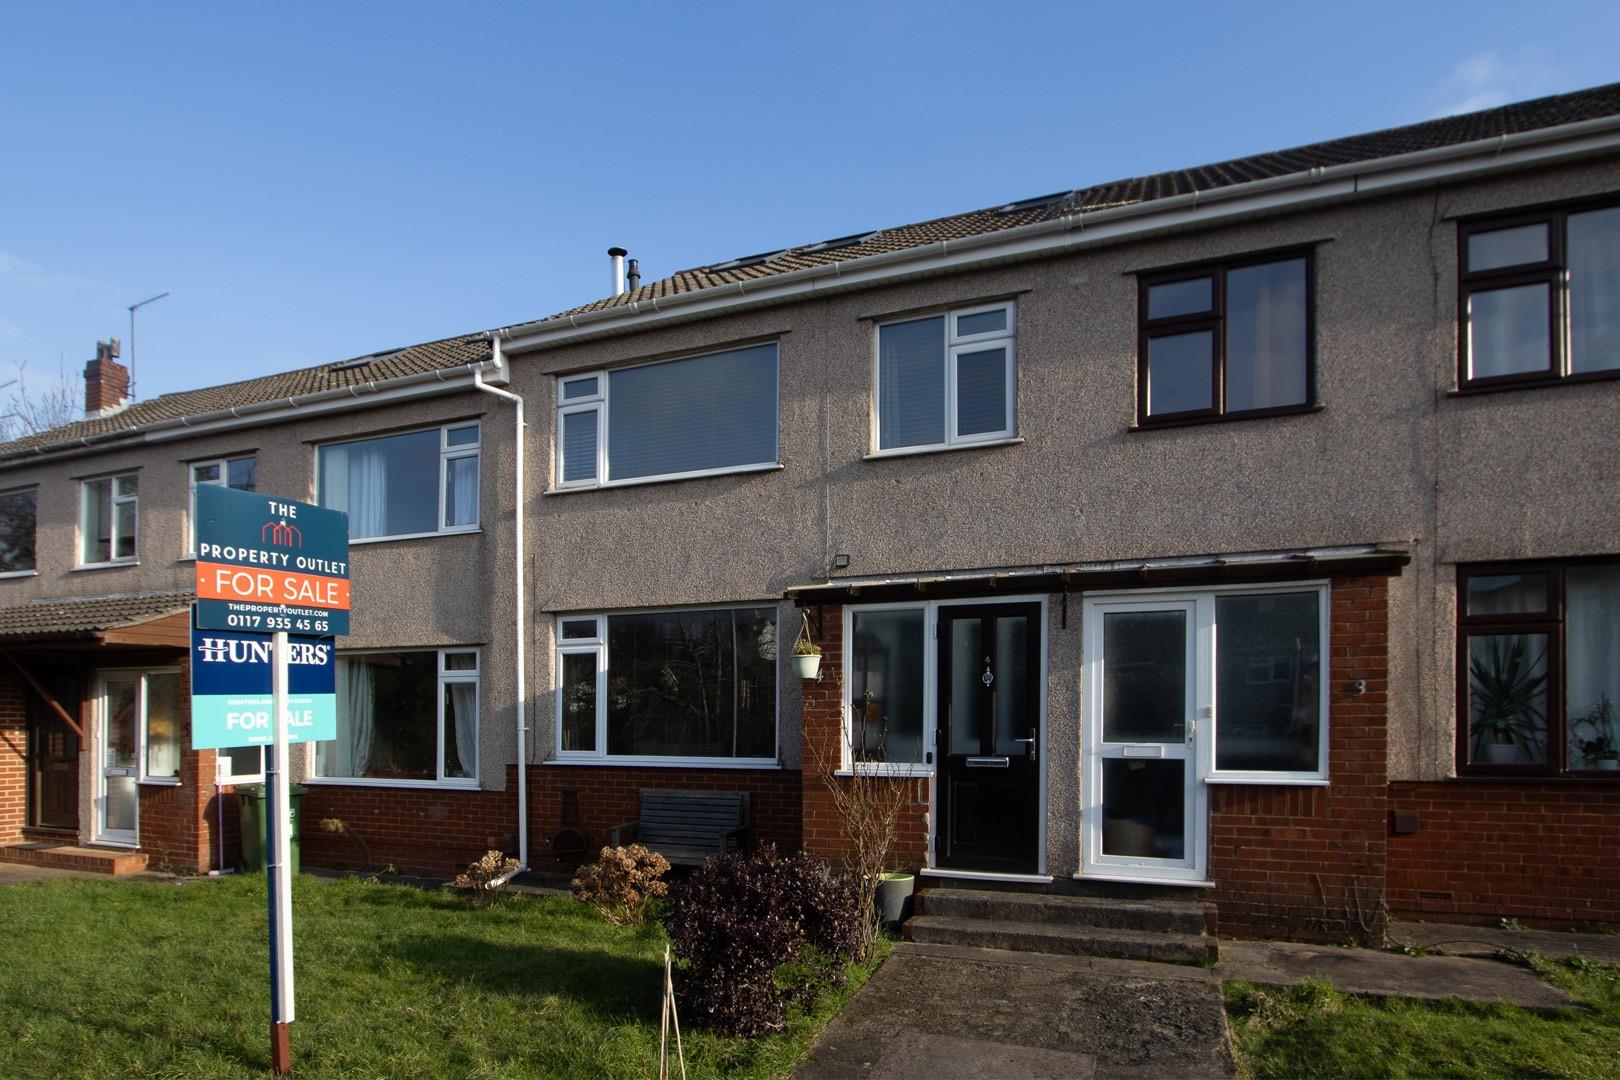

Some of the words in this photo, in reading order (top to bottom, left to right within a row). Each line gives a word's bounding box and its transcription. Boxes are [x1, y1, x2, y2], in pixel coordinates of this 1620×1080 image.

[268, 501, 297, 519] THE
[200, 543, 289, 566] PROPERTY
[296, 557, 346, 575] OUTLET
[216, 569, 274, 598] FOR
[283, 577, 339, 605] SALE
[228, 603, 329, 617] THEPROPERTYOUTLET.COM
[227, 614, 261, 628] 0117
[267, 617, 291, 629] 935
[296, 619, 311, 631] 45
[315, 620, 329, 632] 65
[198, 638, 328, 665] HUNERS
[1353, 680, 1366, 697] 3
[226, 711, 269, 730] FOR
[286, 709, 313, 728] ALE
